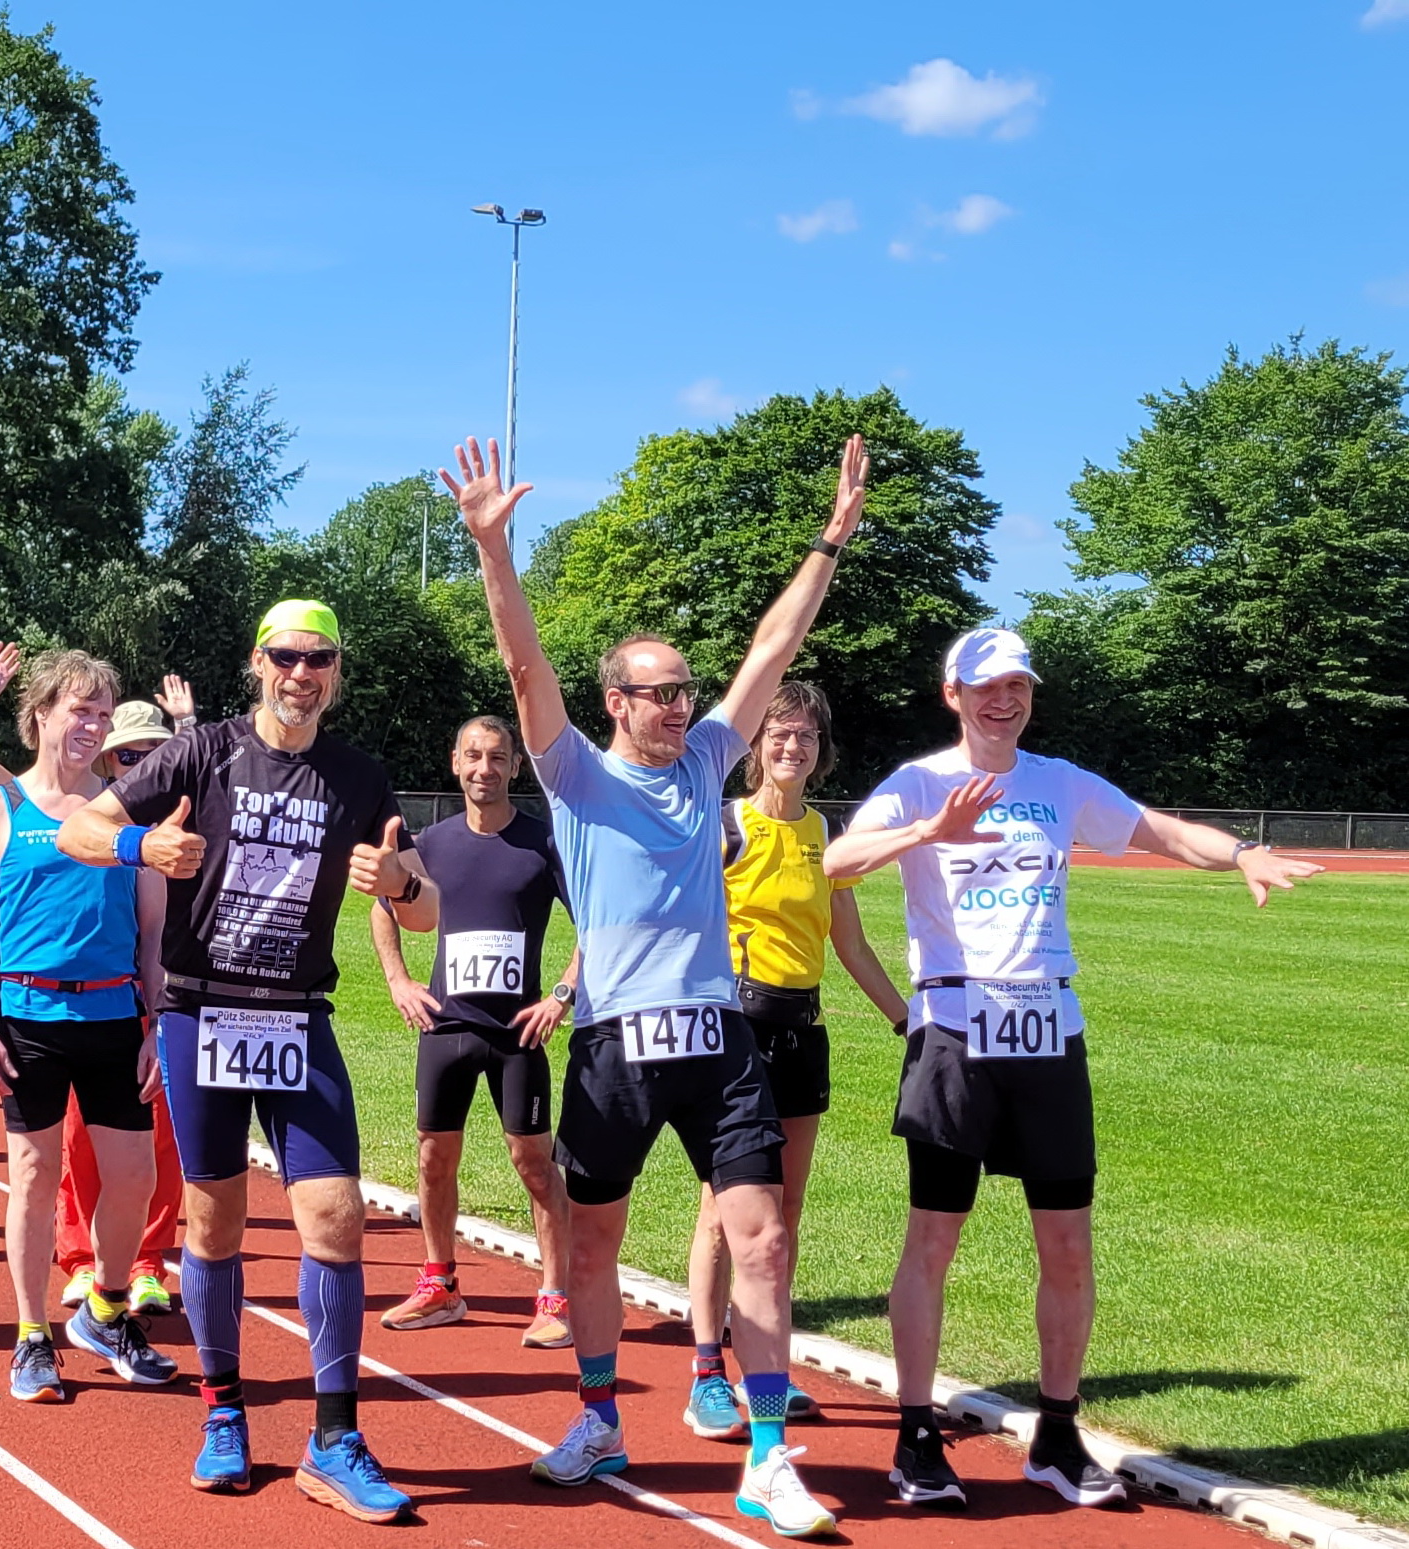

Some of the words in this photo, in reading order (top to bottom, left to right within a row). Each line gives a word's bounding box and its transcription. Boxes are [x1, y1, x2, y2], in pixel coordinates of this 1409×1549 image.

[234, 785, 328, 823] TorTour
[231, 811, 262, 839] de
[267, 815, 325, 848] Ruhr
[1012, 830, 1045, 843] dem
[950, 855, 1068, 875] DACIA
[960, 885, 1061, 911] JOGGER
[448, 954, 521, 990] 1476
[983, 981, 1004, 992] Pütz
[1006, 981, 1041, 994] Security
[1041, 981, 1052, 992] AG
[217, 1010, 238, 1021] Pütz
[239, 1011, 276, 1026] Security
[277, 1014, 292, 1025] AG
[625, 1006, 721, 1057] 1478
[970, 1008, 1058, 1054] 1401
[201, 1038, 304, 1087] 1440
